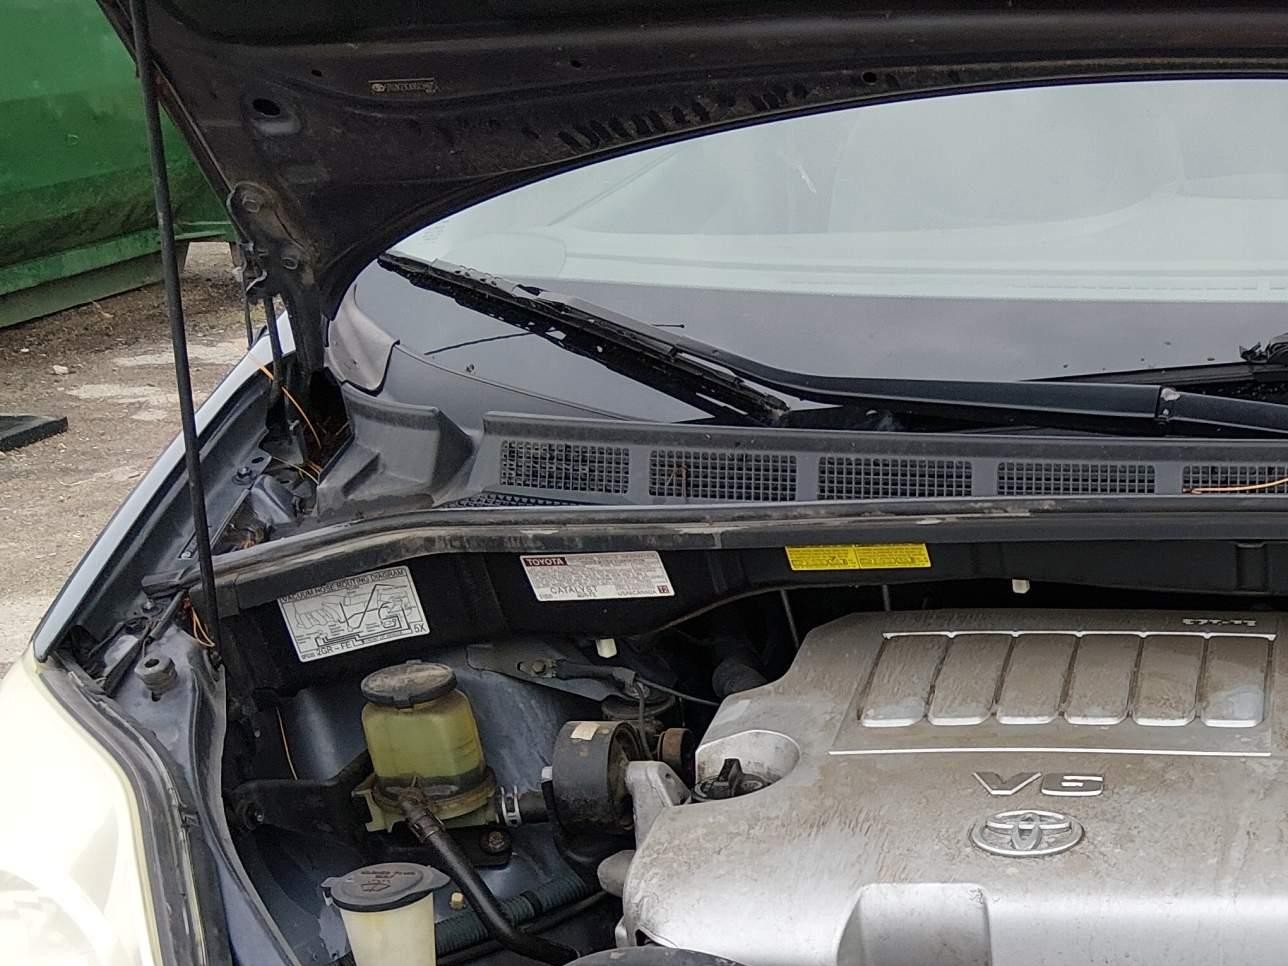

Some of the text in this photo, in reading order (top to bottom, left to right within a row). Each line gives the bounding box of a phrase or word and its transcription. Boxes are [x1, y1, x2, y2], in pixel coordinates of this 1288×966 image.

[526, 558, 564, 566] TOYOTA
[315, 583, 335, 595] HOSE
[337, 575, 369, 588] ROUTING
[371, 568, 404, 582] DIAGRAM
[551, 584, 598, 595] CATALYST
[413, 623, 427, 633] 5X
[973, 771, 1104, 797] V6
